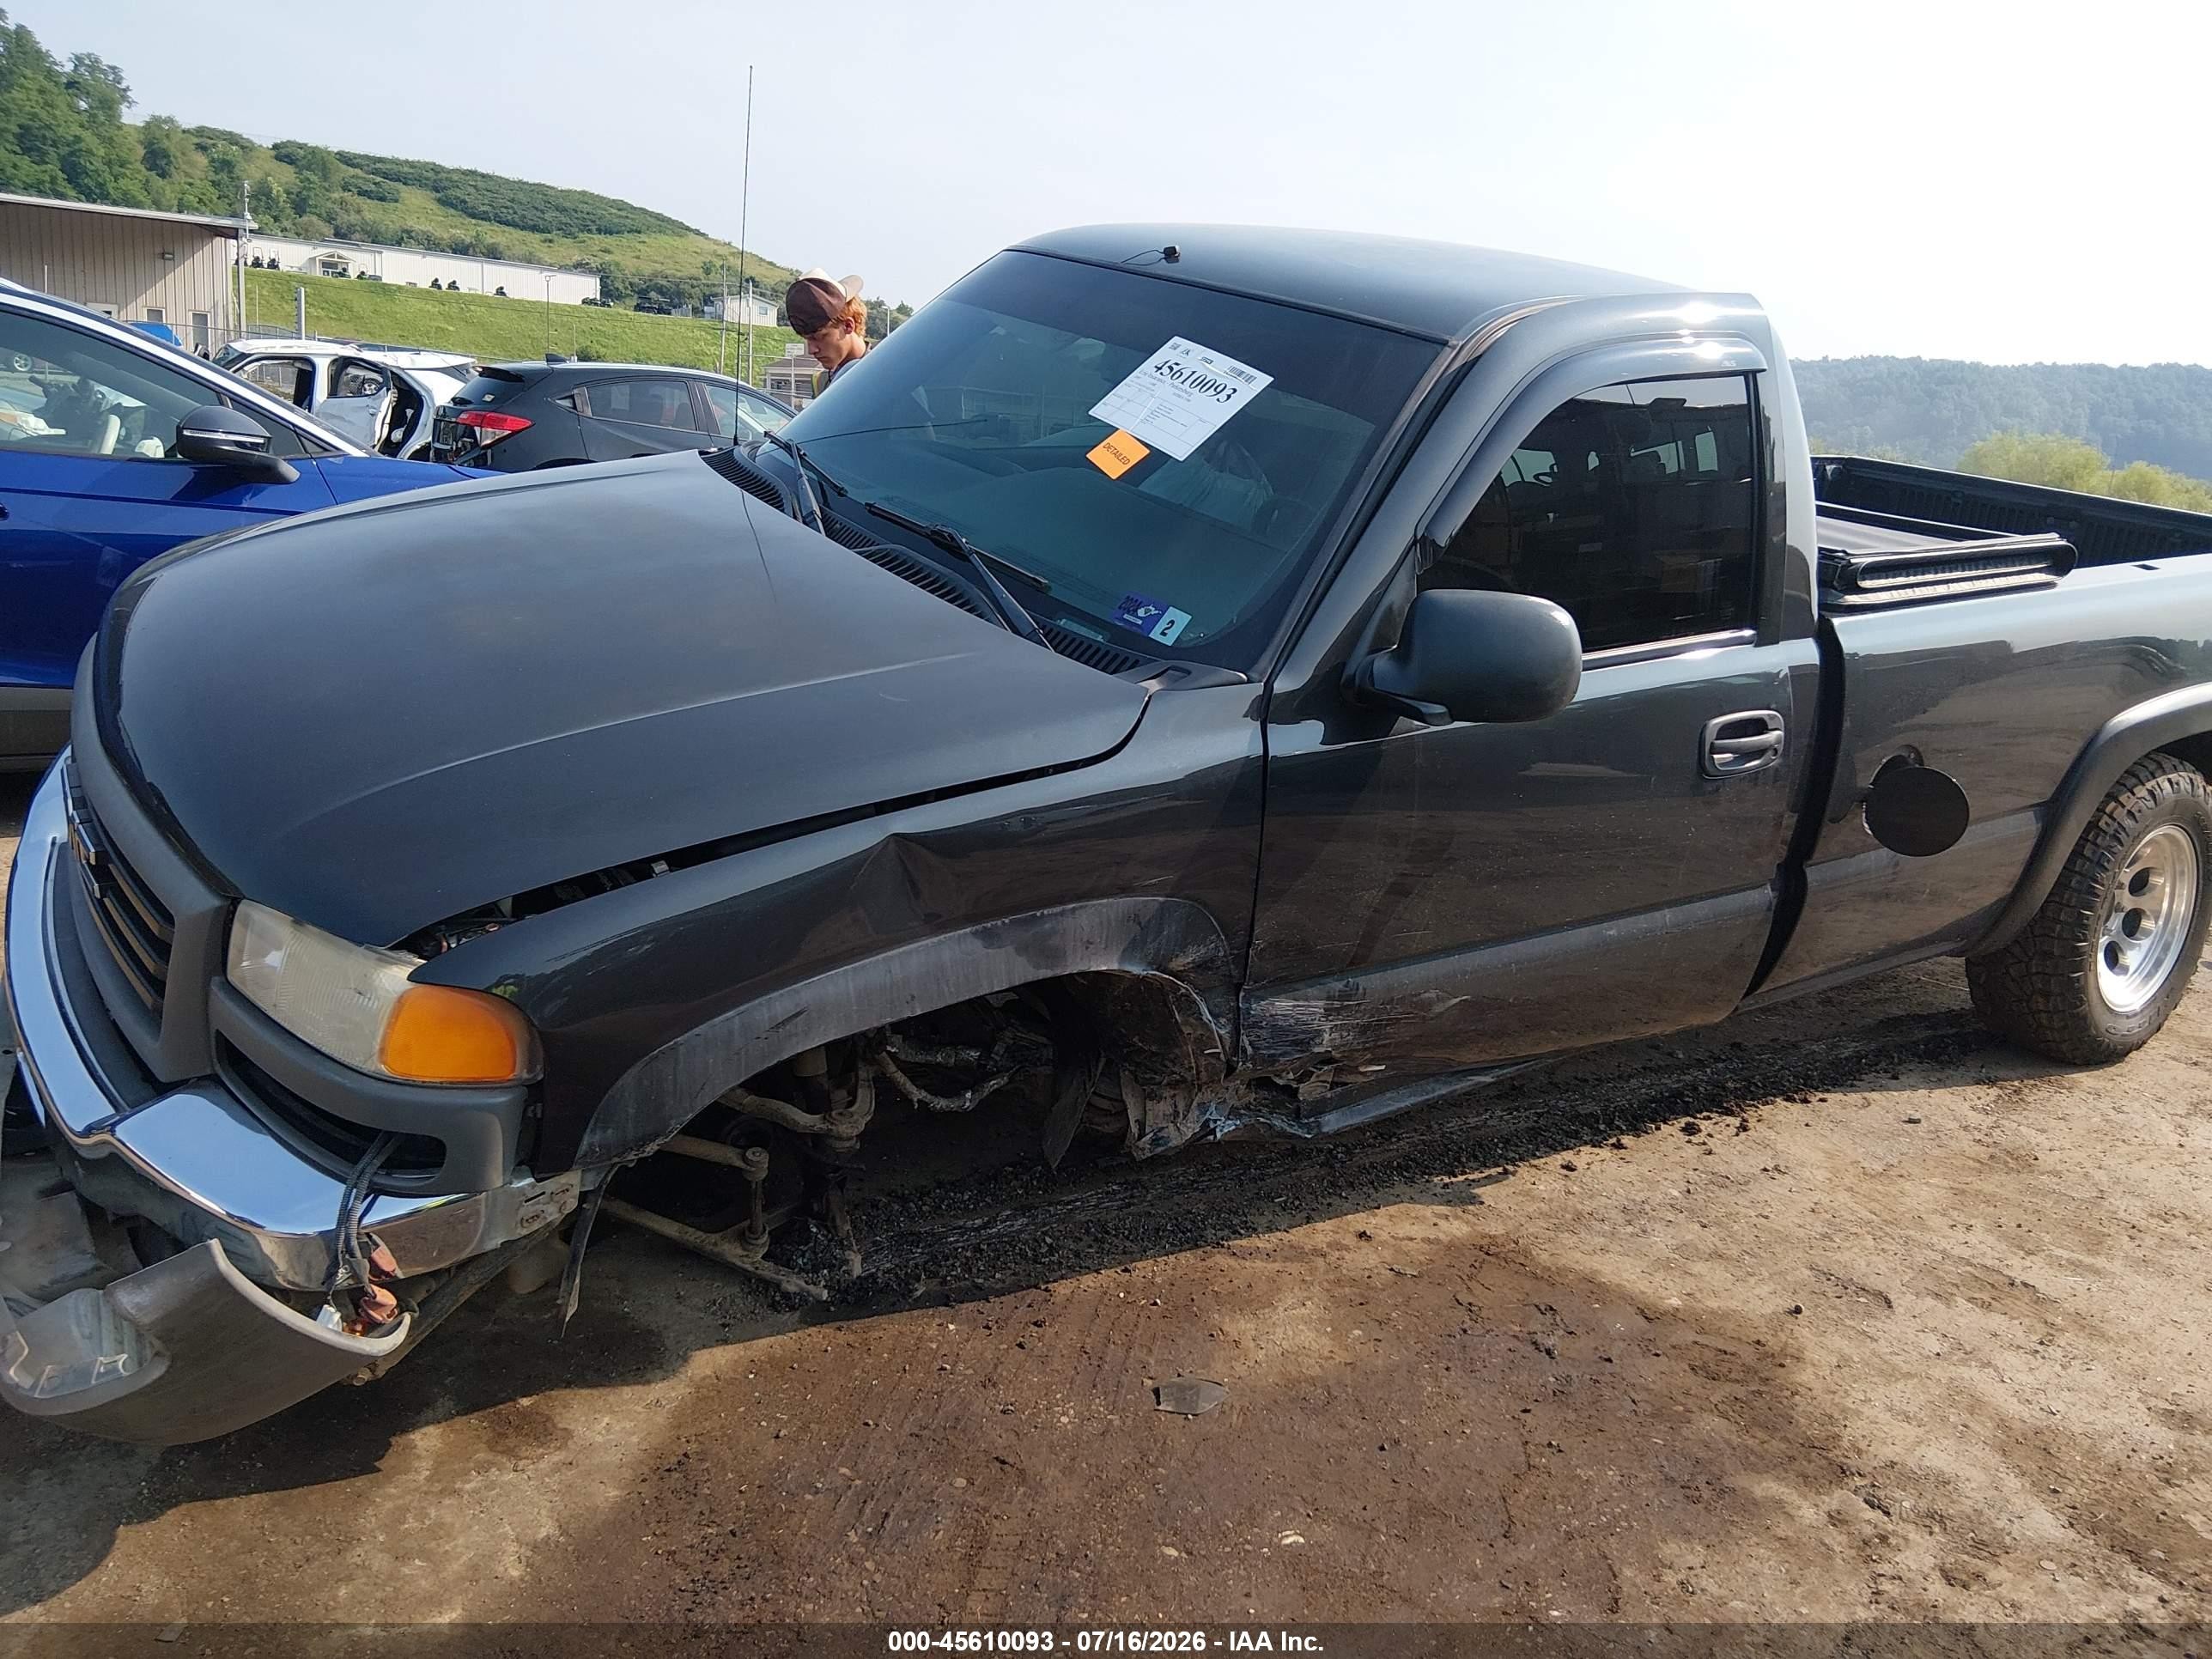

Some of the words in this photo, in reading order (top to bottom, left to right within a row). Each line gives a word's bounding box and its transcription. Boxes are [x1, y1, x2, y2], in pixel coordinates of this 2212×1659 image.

[1153, 357, 1238, 404] 45610093
[1102, 441, 1132, 466] DETAILED
[1159, 619, 1176, 637] 2
